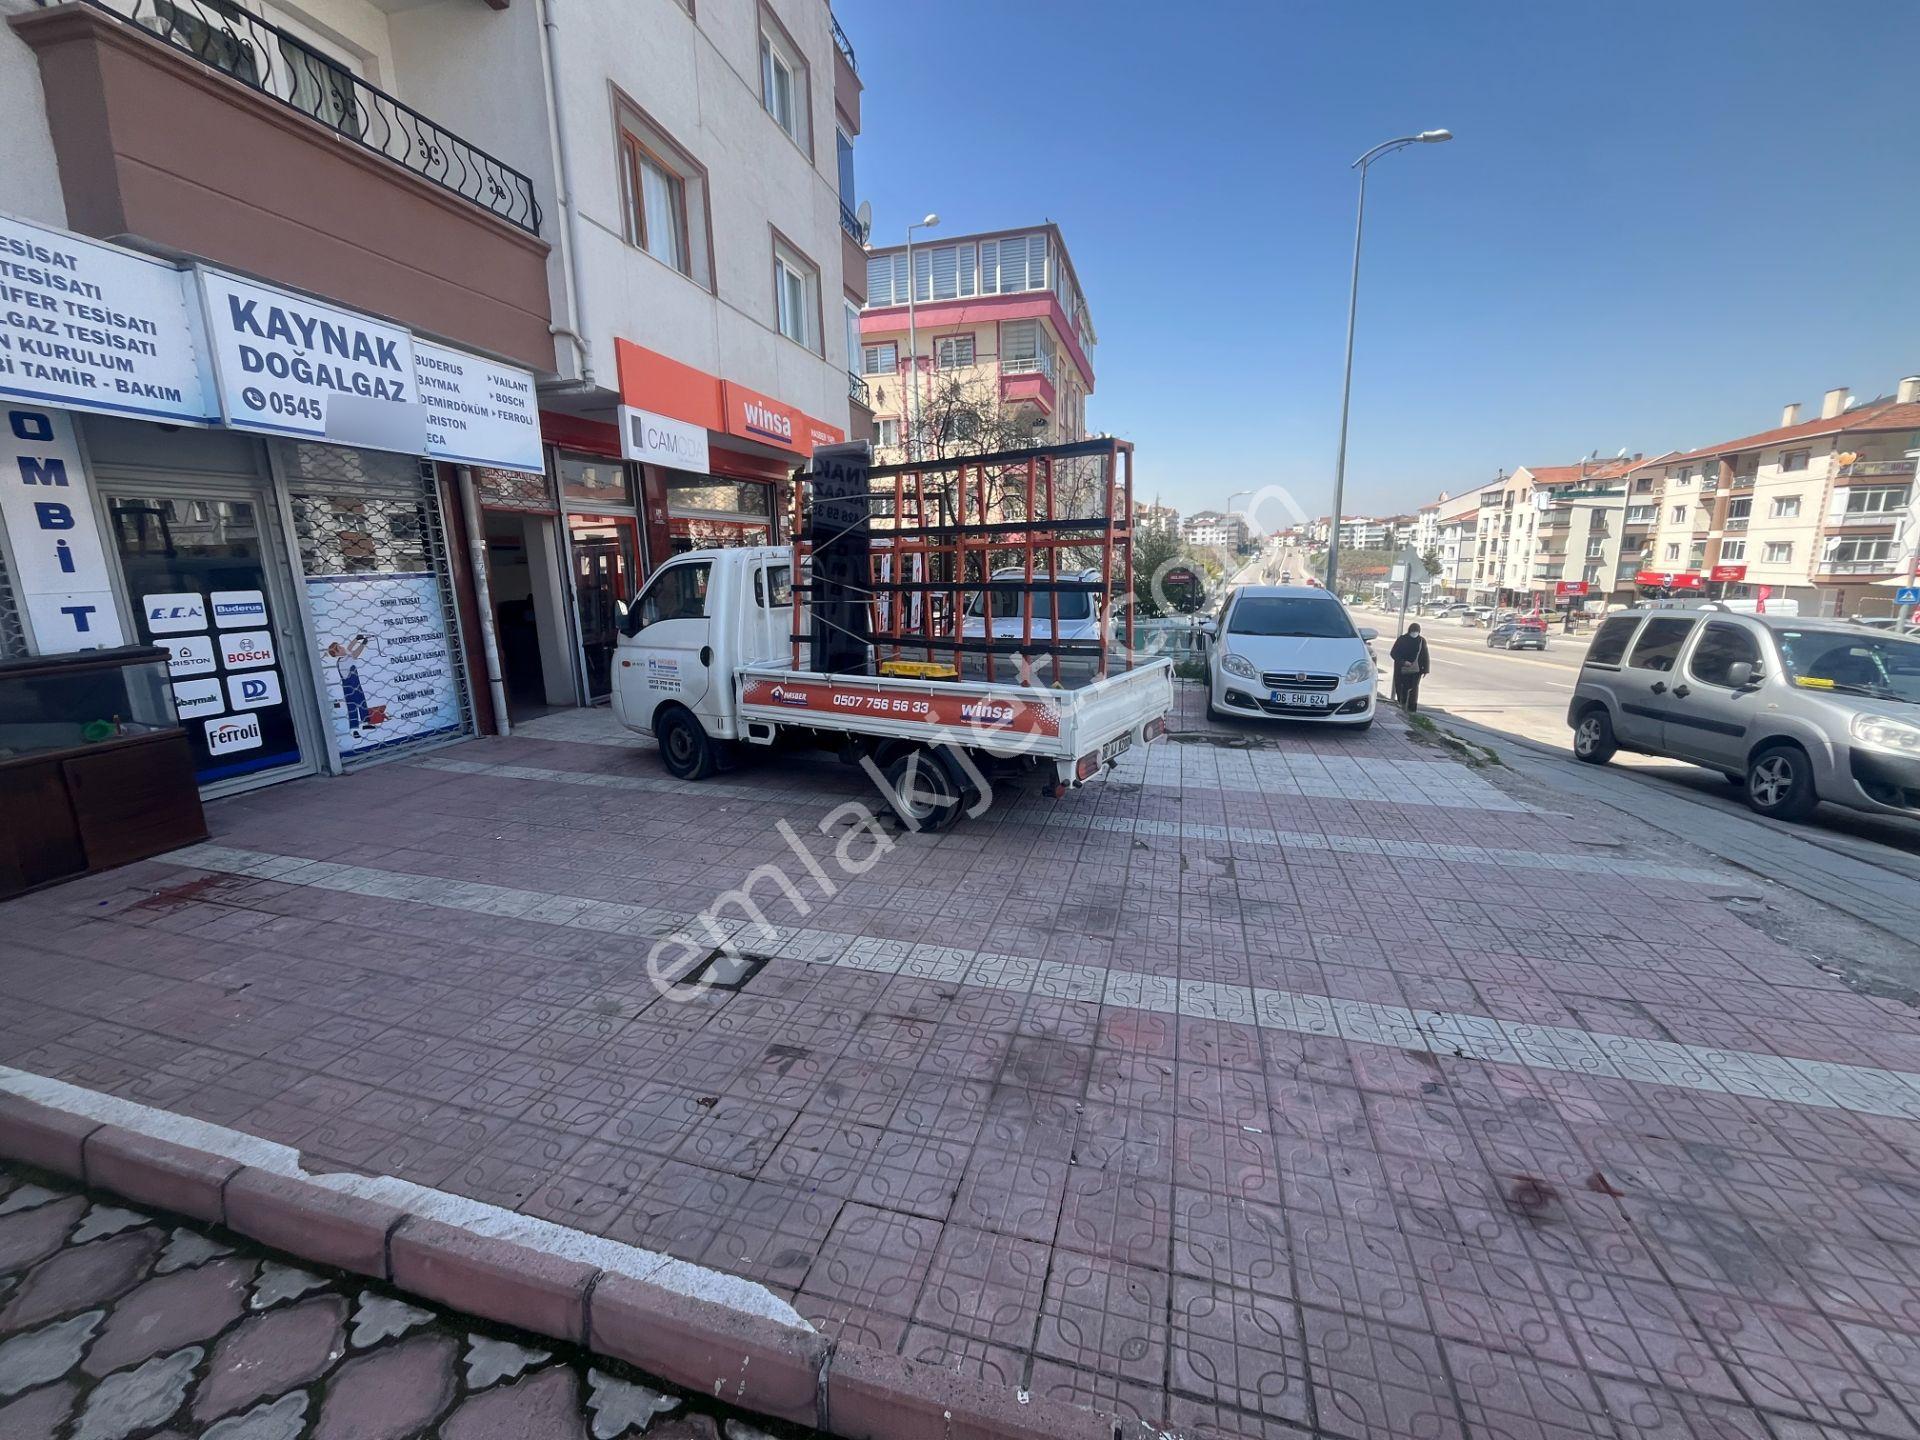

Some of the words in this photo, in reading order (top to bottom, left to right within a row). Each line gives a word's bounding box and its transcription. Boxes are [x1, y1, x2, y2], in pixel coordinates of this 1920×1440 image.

[63, 300, 157, 336] TESİSATI
[63, 323, 157, 357] TESİSATI
[228, 294, 402, 372] KAYNAK
[18, 337, 134, 373] KURULUM
[415, 354, 463, 376] BUDERUS
[20, 361, 97, 388] TAMİR
[115, 378, 182, 403] BAKIM
[239, 344, 407, 402] DOĞALGAZ
[493, 375, 528, 393] VAILANT
[418, 375, 460, 394] BAYMAK
[270, 391, 322, 421] 0545
[421, 394, 489, 417] DEMİRDÖKÜM
[495, 393, 525, 408] BOSCH
[743, 401, 792, 437] winsa
[217, 602, 262, 613] Buderus
[228, 650, 270, 663] BOSCH
[181, 694, 217, 706] baymak
[783, 691, 807, 700] HASBER
[833, 694, 863, 707] 0507
[866, 697, 889, 710] 756
[892, 700, 909, 711] 56
[912, 701, 929, 713] 33
[1276, 694, 1286, 702] 06
[1292, 694, 1307, 703] EHU
[1310, 696, 1324, 704] 624
[961, 701, 1014, 720] winsa
[209, 723, 259, 748] Ferroli
